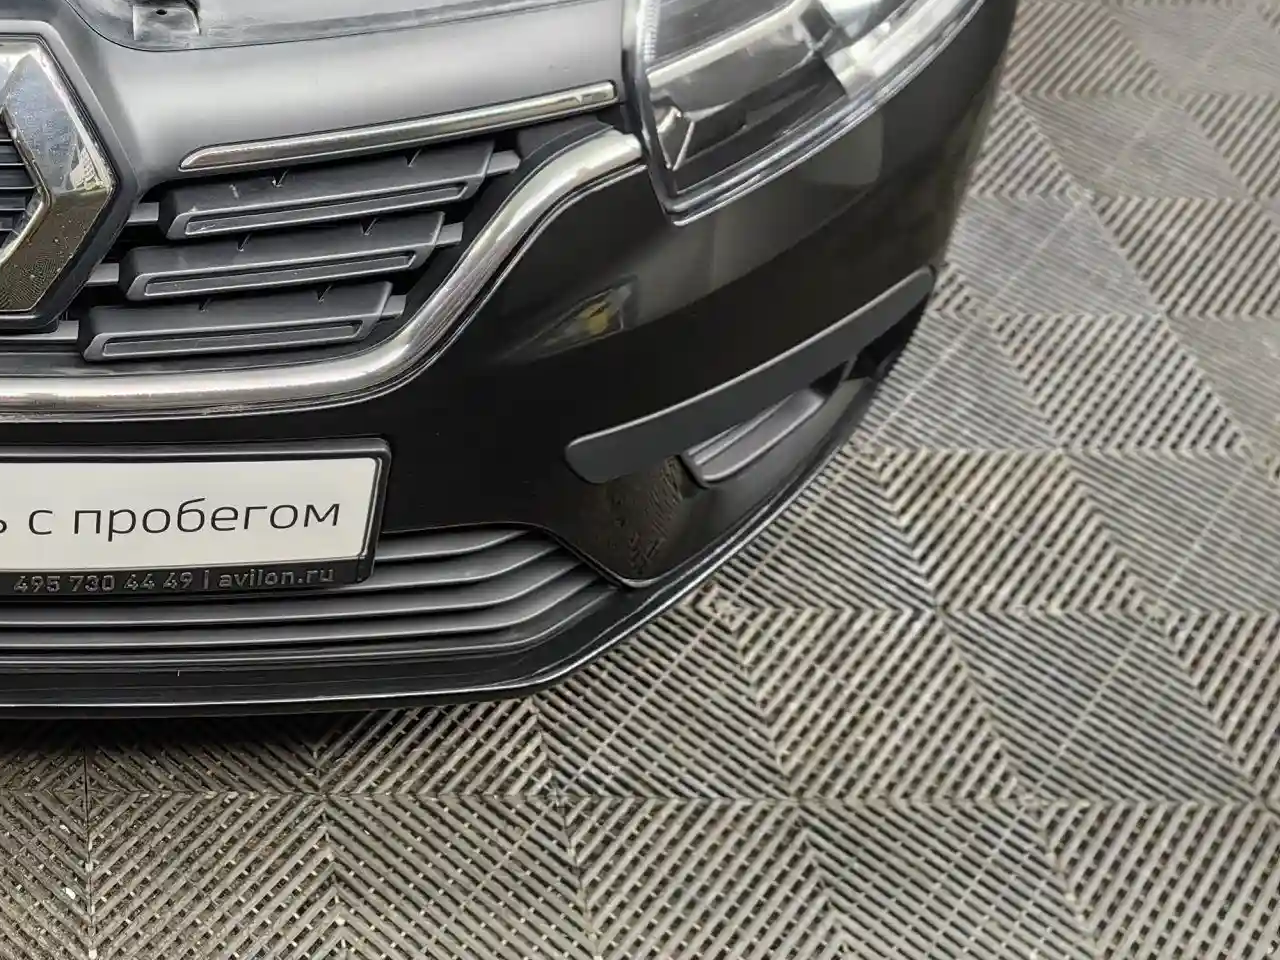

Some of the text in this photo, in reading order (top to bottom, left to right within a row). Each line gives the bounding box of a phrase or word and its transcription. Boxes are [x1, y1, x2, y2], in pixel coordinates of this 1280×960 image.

[28, 509, 54, 535] с
[74, 497, 340, 542] пробегом
[13, 575, 61, 593] 495
[69, 574, 116, 592] 730
[123, 573, 156, 590] 44
[162, 571, 194, 589] 49
[219, 568, 334, 588] avilon.ru
